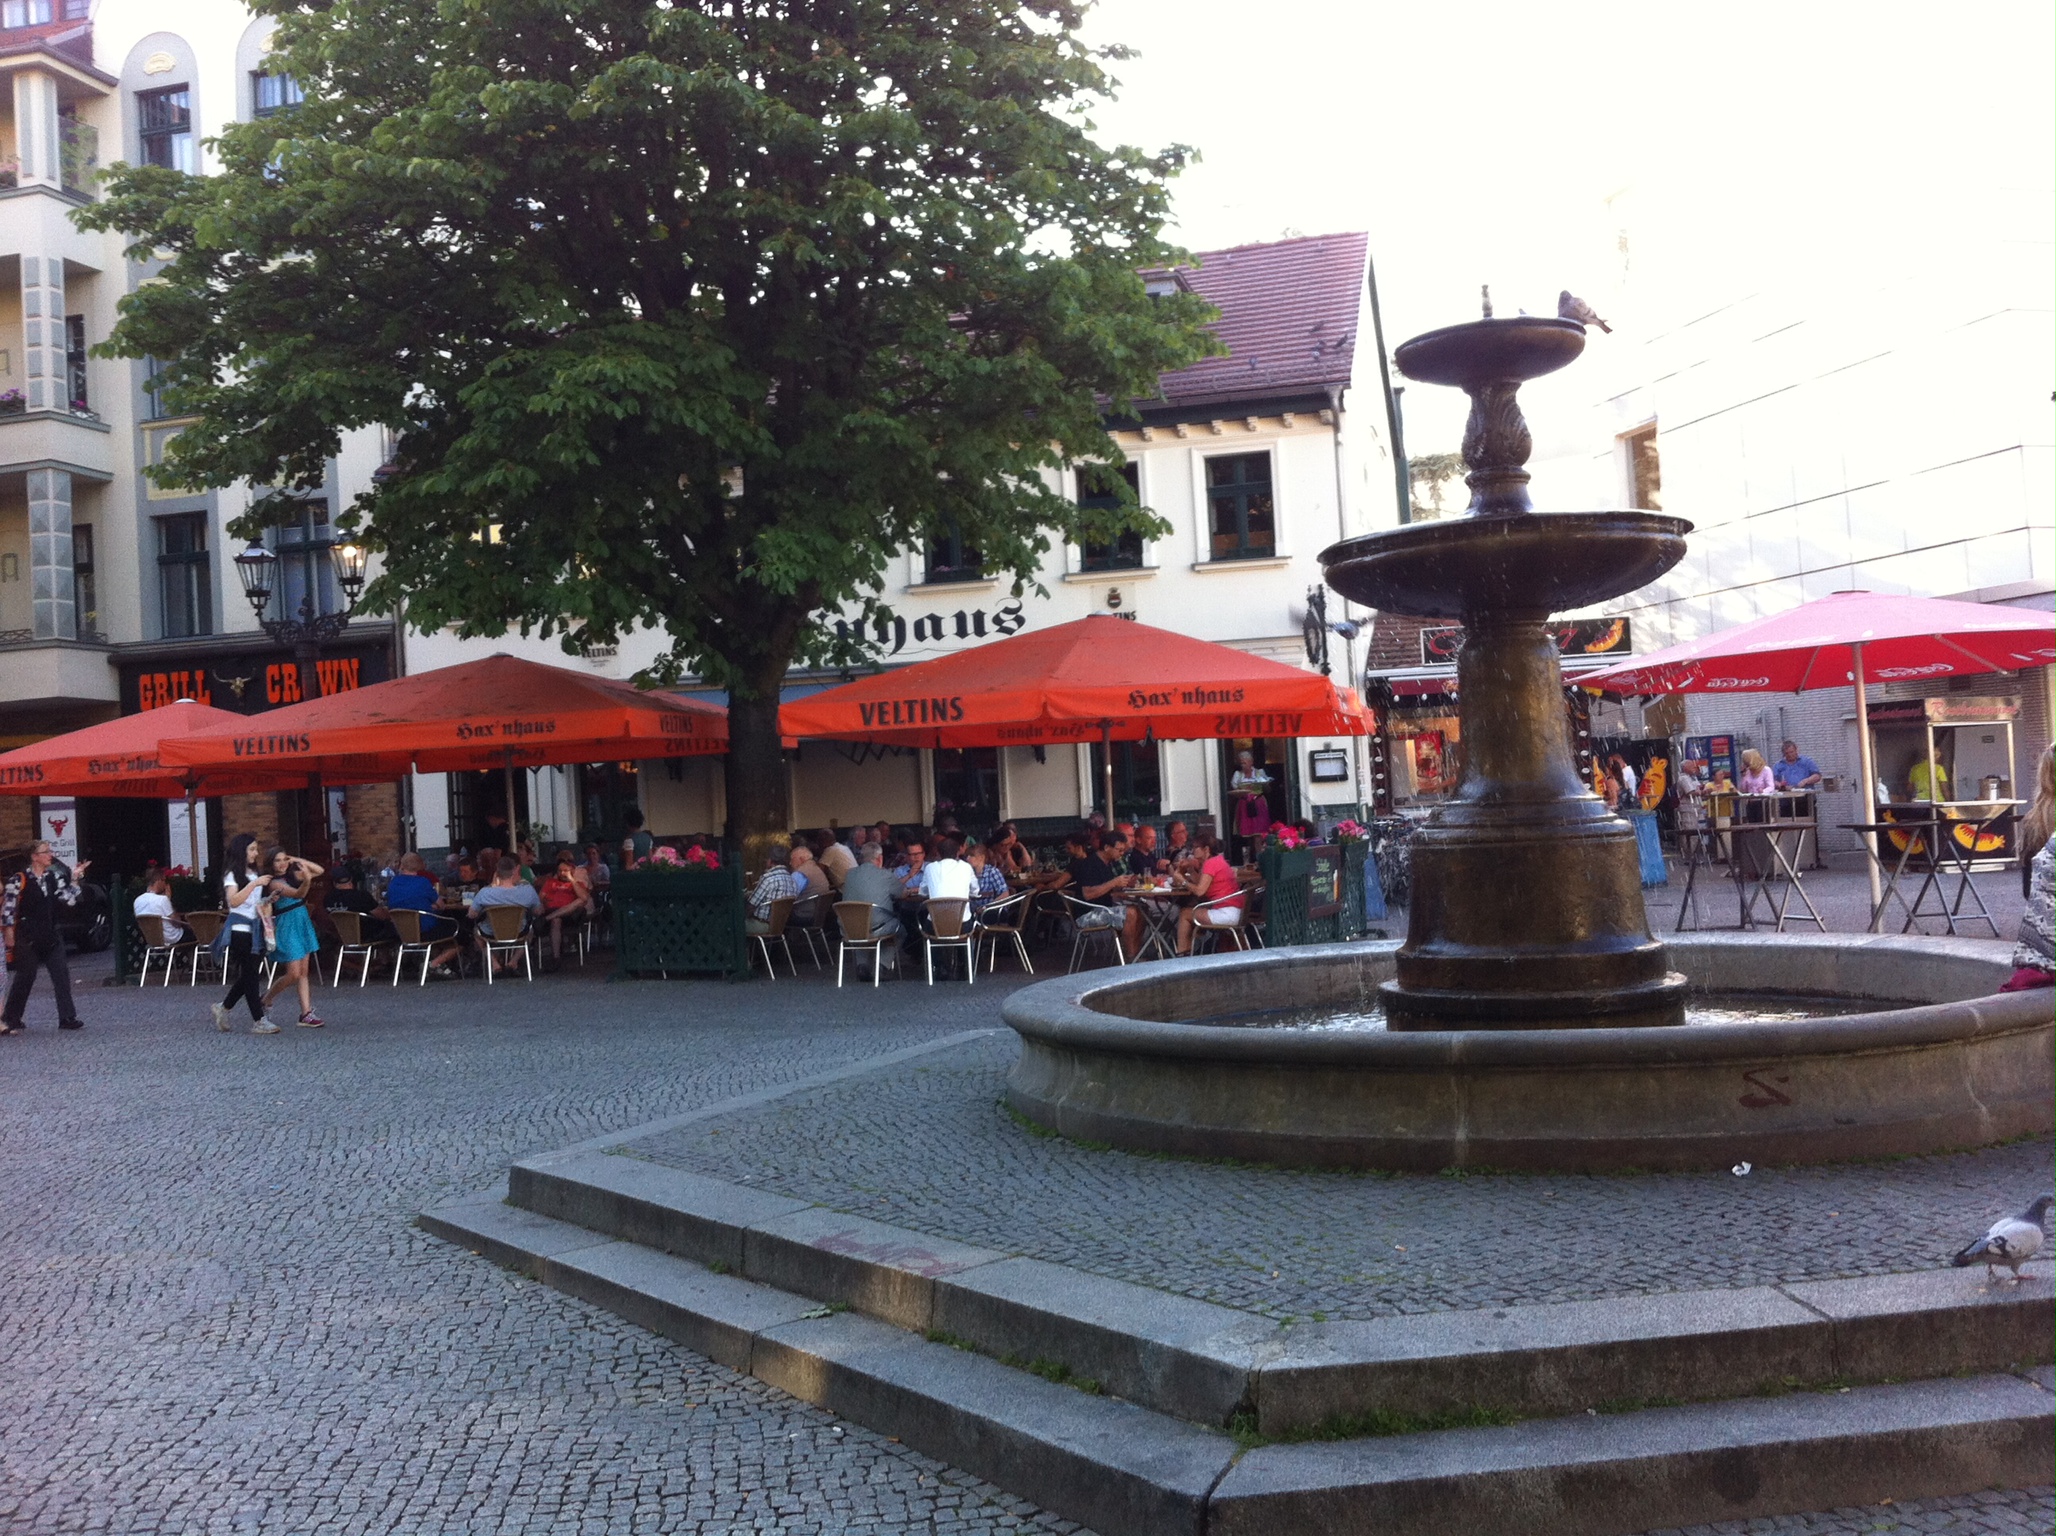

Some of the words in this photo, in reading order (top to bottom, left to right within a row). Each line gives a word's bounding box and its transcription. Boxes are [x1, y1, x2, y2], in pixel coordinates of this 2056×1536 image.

[1112, 611, 1136, 621] TINS
[139, 670, 211, 712] GRILL
[266, 658, 360, 703] CRWN
[859, 697, 964, 727] VELTINS
[232, 733, 311, 757] VELTINS
[0, 764, 44, 786] LTINS
